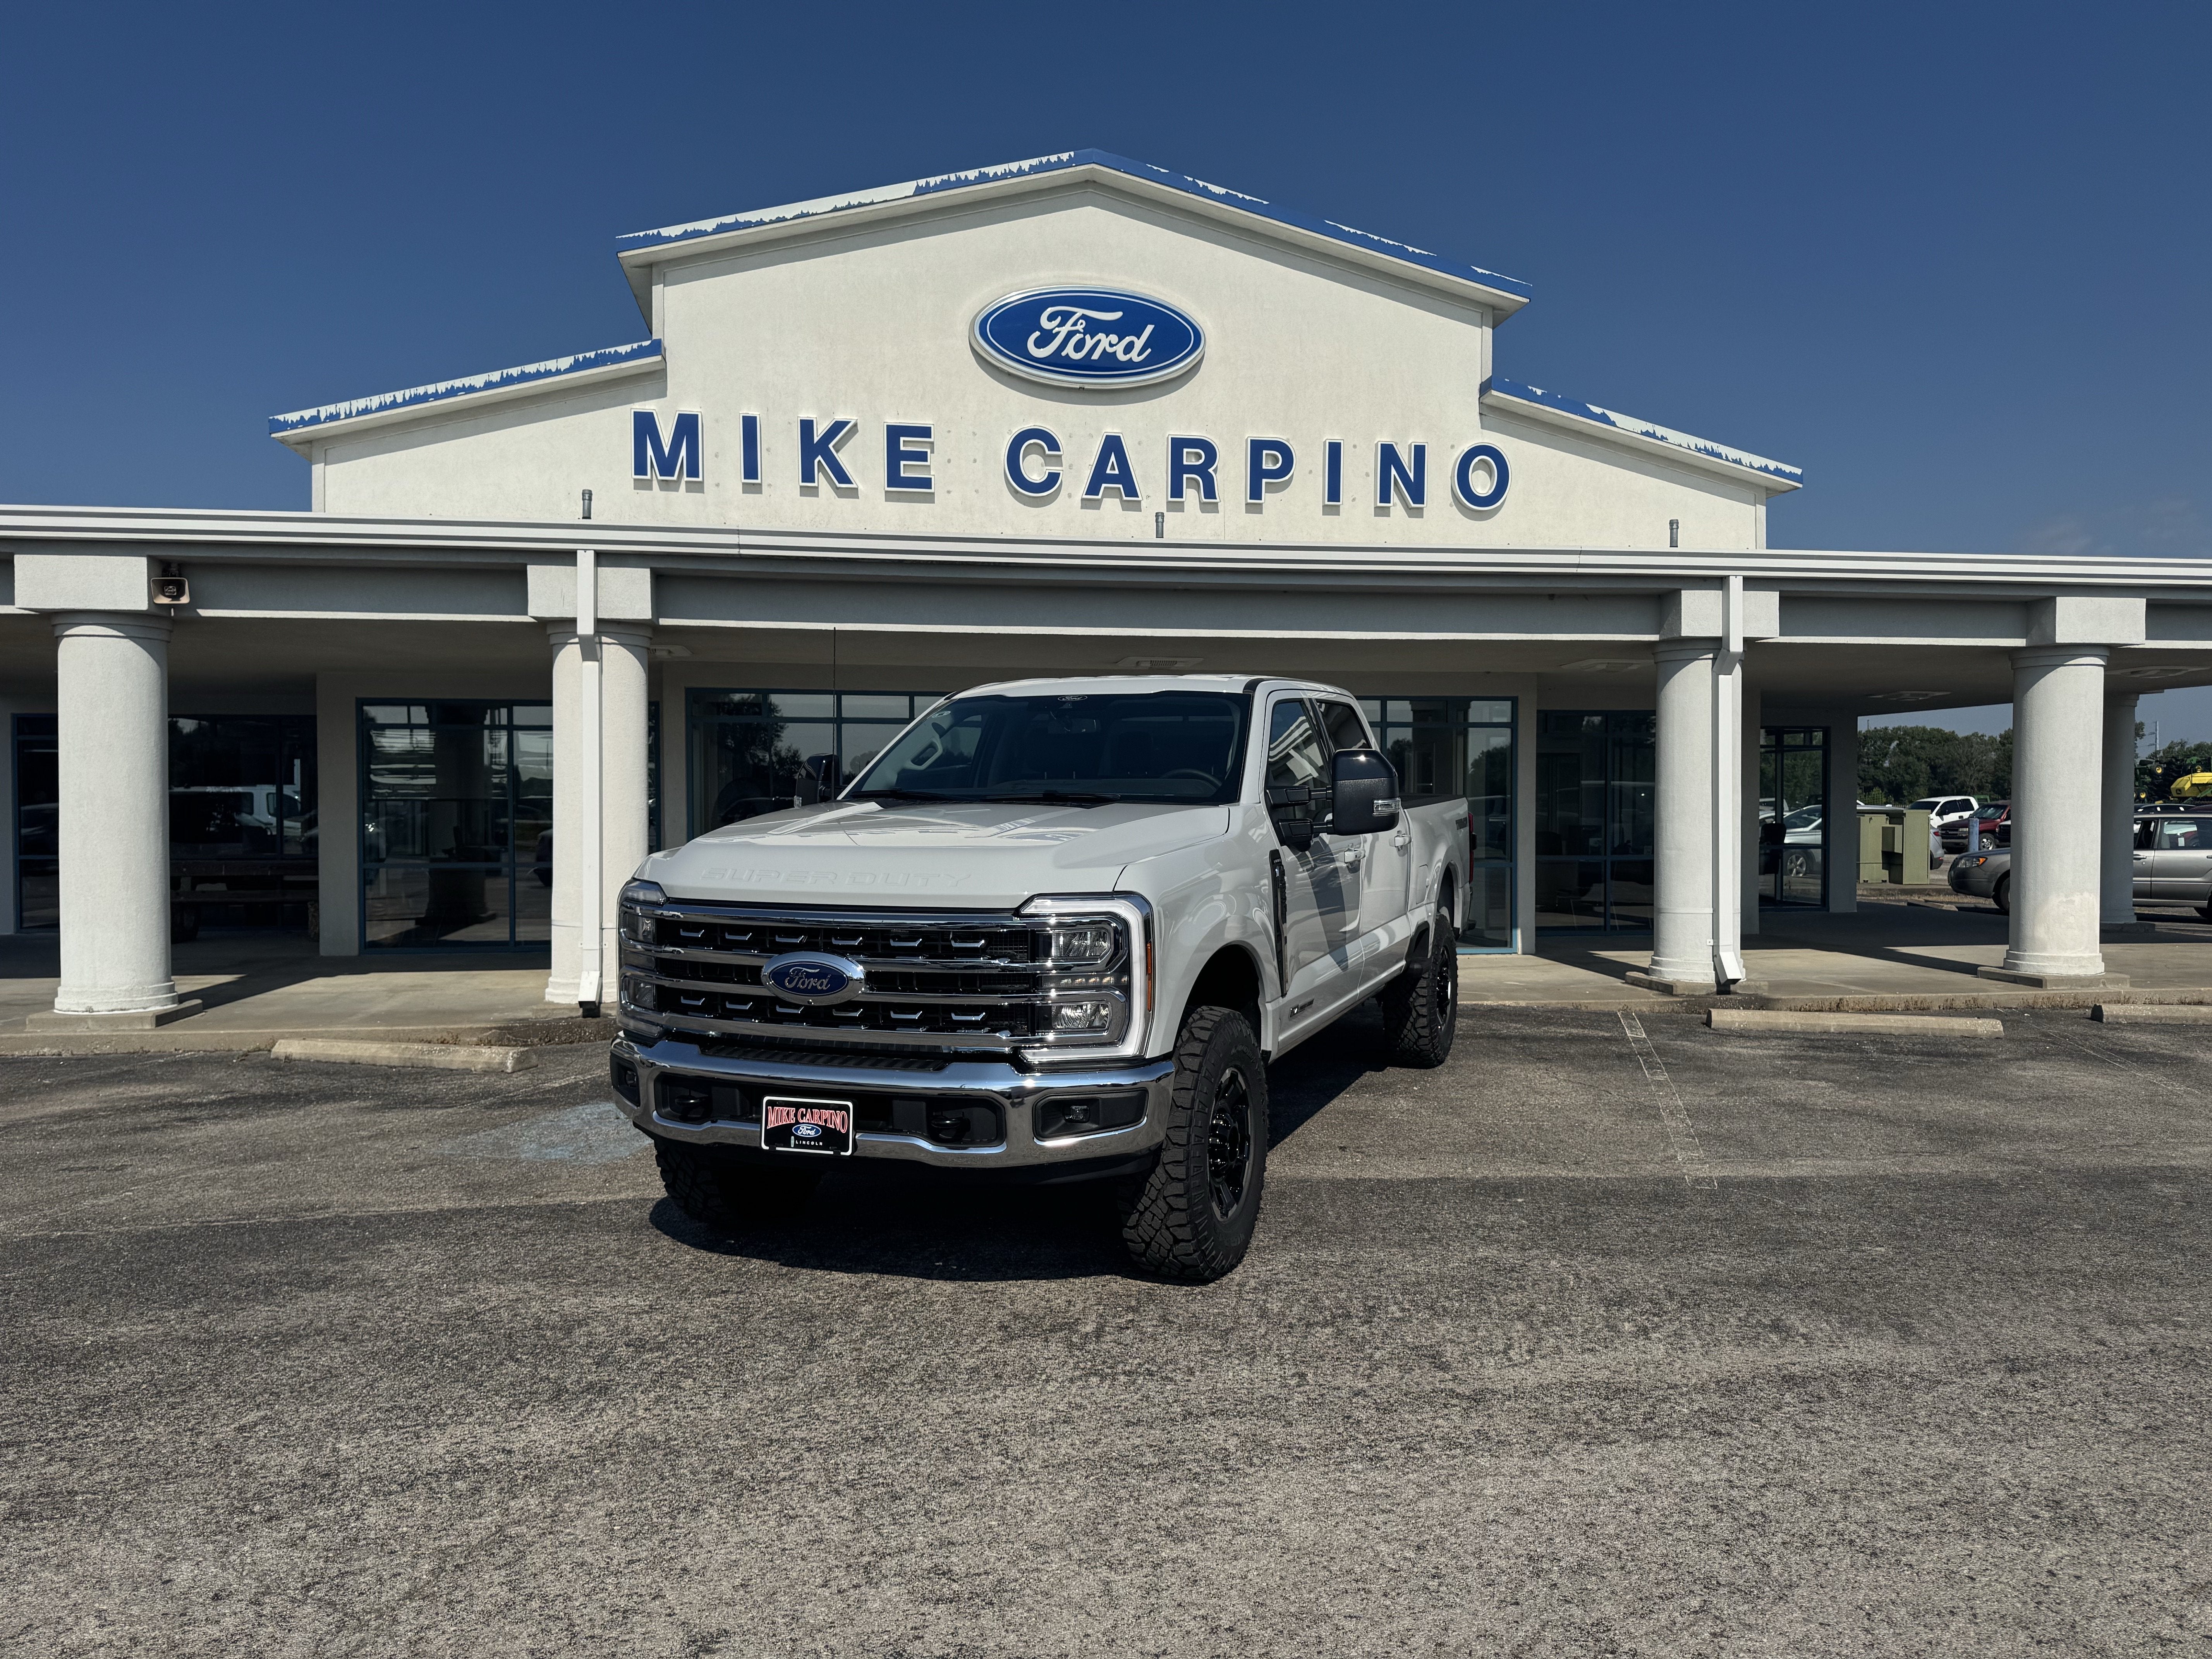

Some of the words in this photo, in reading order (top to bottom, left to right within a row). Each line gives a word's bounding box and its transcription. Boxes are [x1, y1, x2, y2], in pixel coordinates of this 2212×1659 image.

[1027, 306, 1155, 362] Ford
[630, 409, 935, 492] MIKE
[1004, 425, 1512, 511] CARPINO
[701, 867, 836, 885] SUPER
[845, 872, 972, 887] DUTY
[785, 967, 831, 990] Ford
[767, 1106, 795, 1129] MIKE
[797, 1108, 848, 1133] CARPINO
[797, 1126, 816, 1135] Ford
